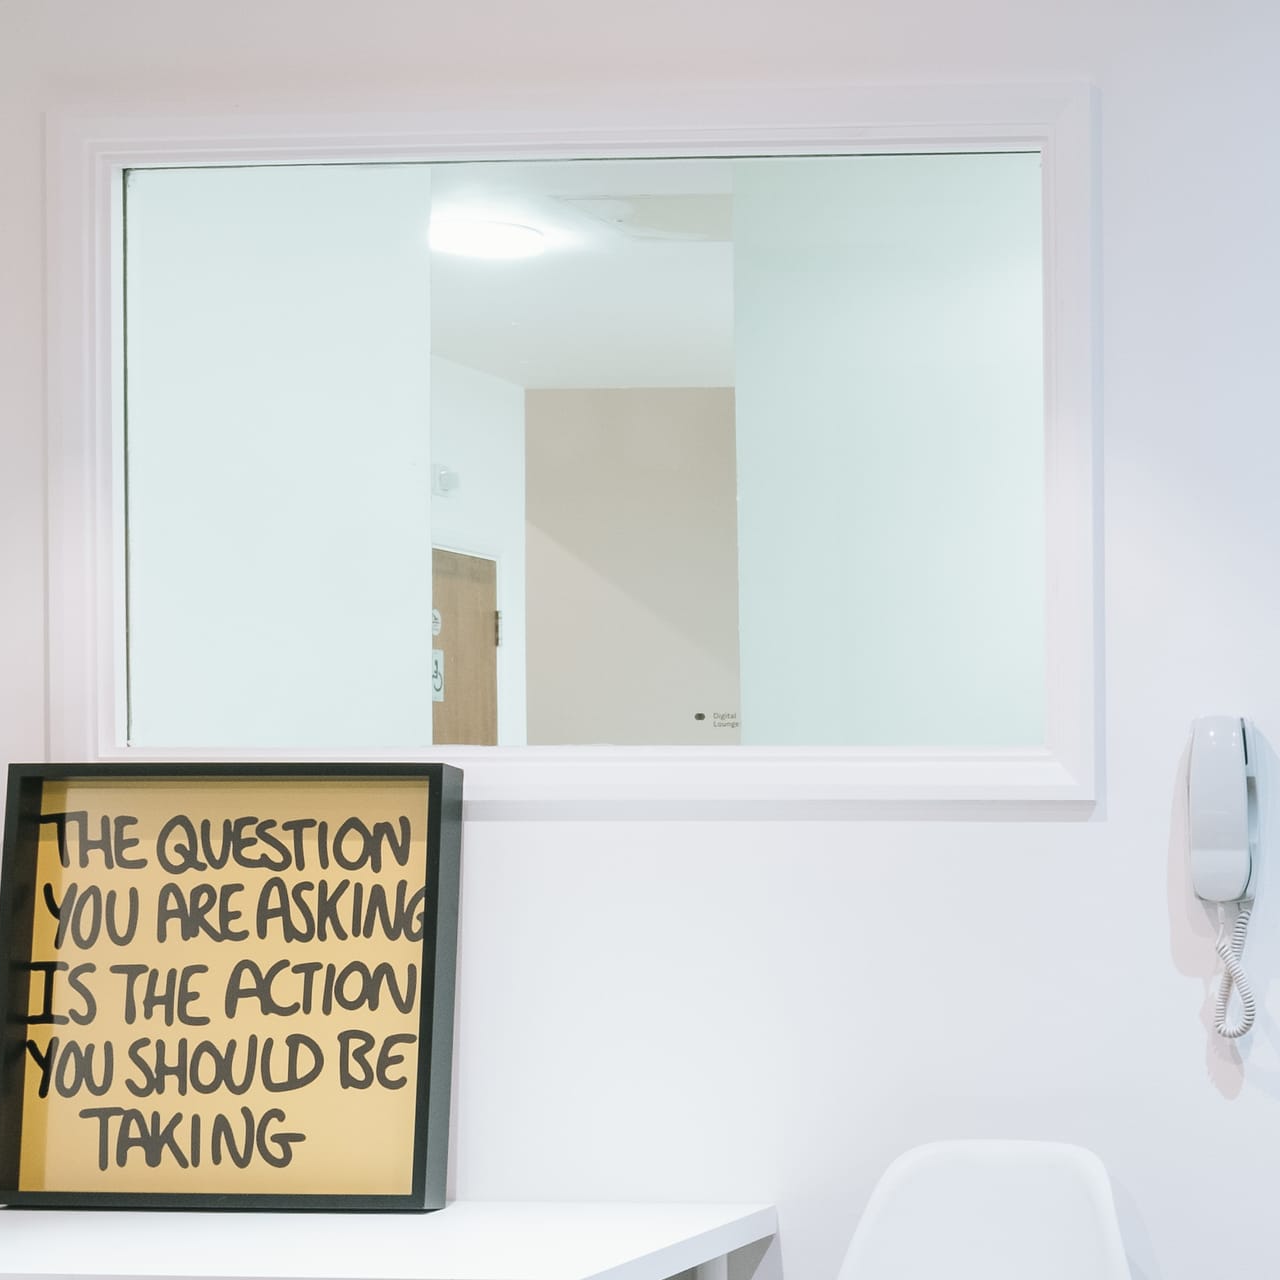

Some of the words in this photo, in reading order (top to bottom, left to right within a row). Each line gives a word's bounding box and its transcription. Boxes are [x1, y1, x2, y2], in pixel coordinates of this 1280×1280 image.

[713, 712, 737, 721] Digital
[713, 721, 741, 729] Lounge
[39, 811, 148, 869] THE
[157, 814, 412, 874] QUESTION
[43, 882, 139, 949] YOU
[157, 882, 250, 943] ARE
[24, 960, 97, 1026] IS
[110, 963, 210, 1027] THE
[225, 958, 417, 1019] ACTION
[25, 1036, 114, 1099] YOU
[125, 1033, 325, 1098] SHOULD
[337, 1029, 417, 1090] BE
[78, 1106, 306, 1171] TAKING
